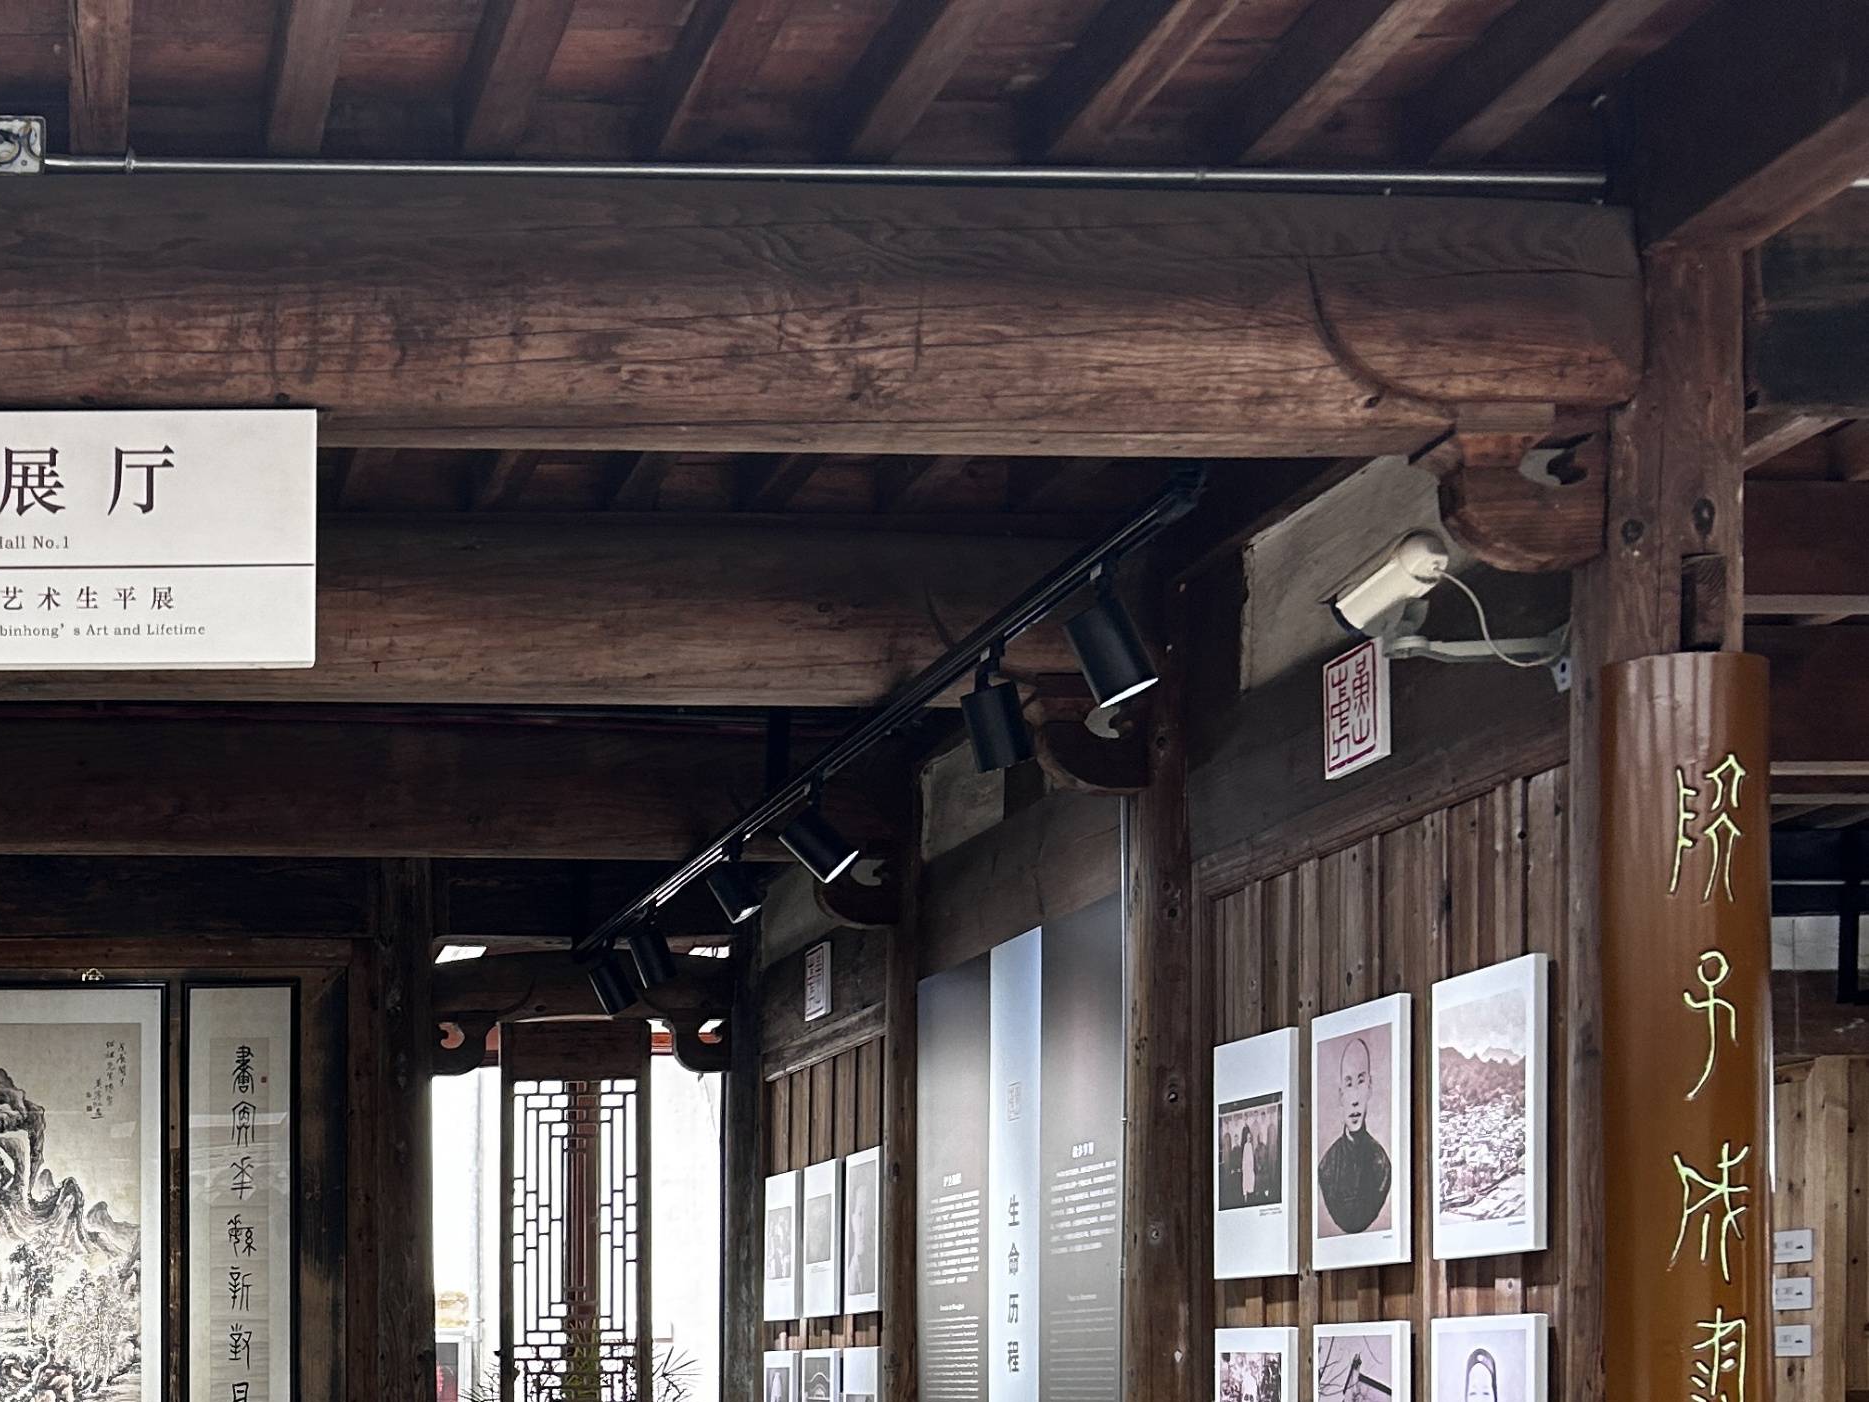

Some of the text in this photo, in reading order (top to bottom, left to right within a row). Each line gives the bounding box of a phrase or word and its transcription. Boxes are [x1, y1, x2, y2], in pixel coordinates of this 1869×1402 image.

[32, 535, 69, 550] No.1
[86, 623, 108, 637] Art
[114, 623, 141, 637] and
[147, 623, 206, 637] Lifetime
[1007, 1194, 1020, 1373] 生命历程
